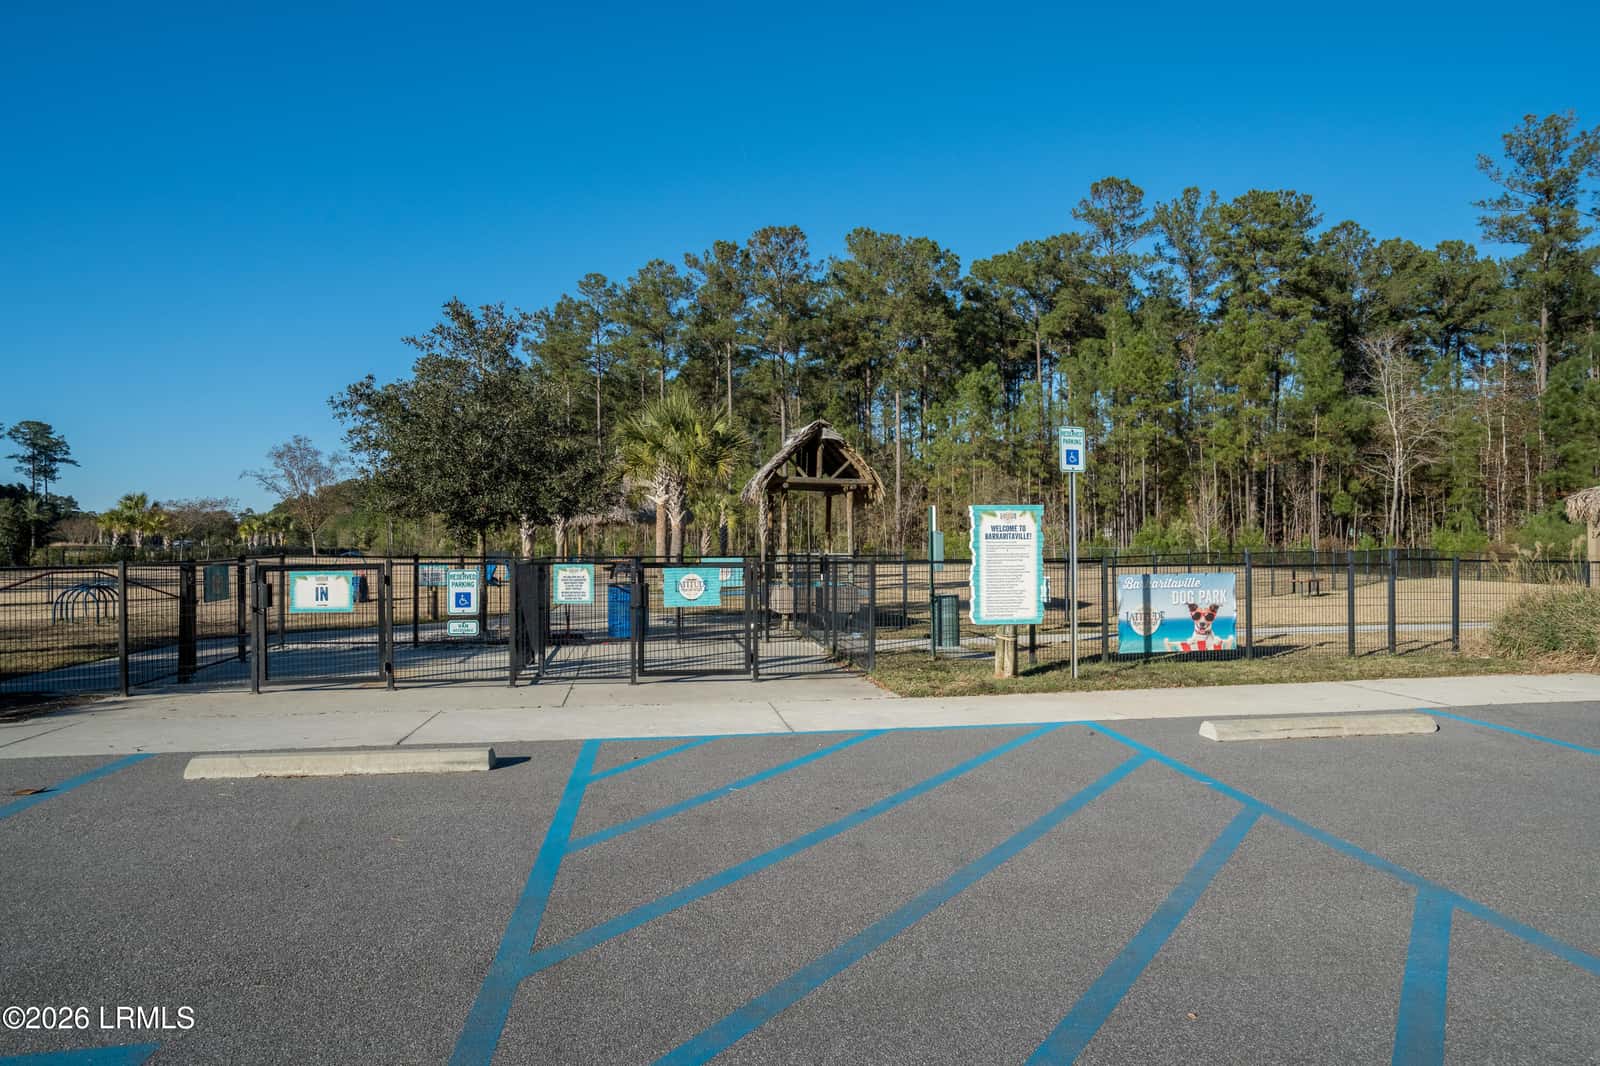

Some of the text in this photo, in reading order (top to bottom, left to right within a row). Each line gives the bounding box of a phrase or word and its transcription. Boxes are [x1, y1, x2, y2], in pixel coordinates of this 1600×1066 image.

[1122, 576, 1202, 590] Baaritaville
[315, 586, 329, 601] IN
[1172, 589, 1227, 605] DOG PARK
